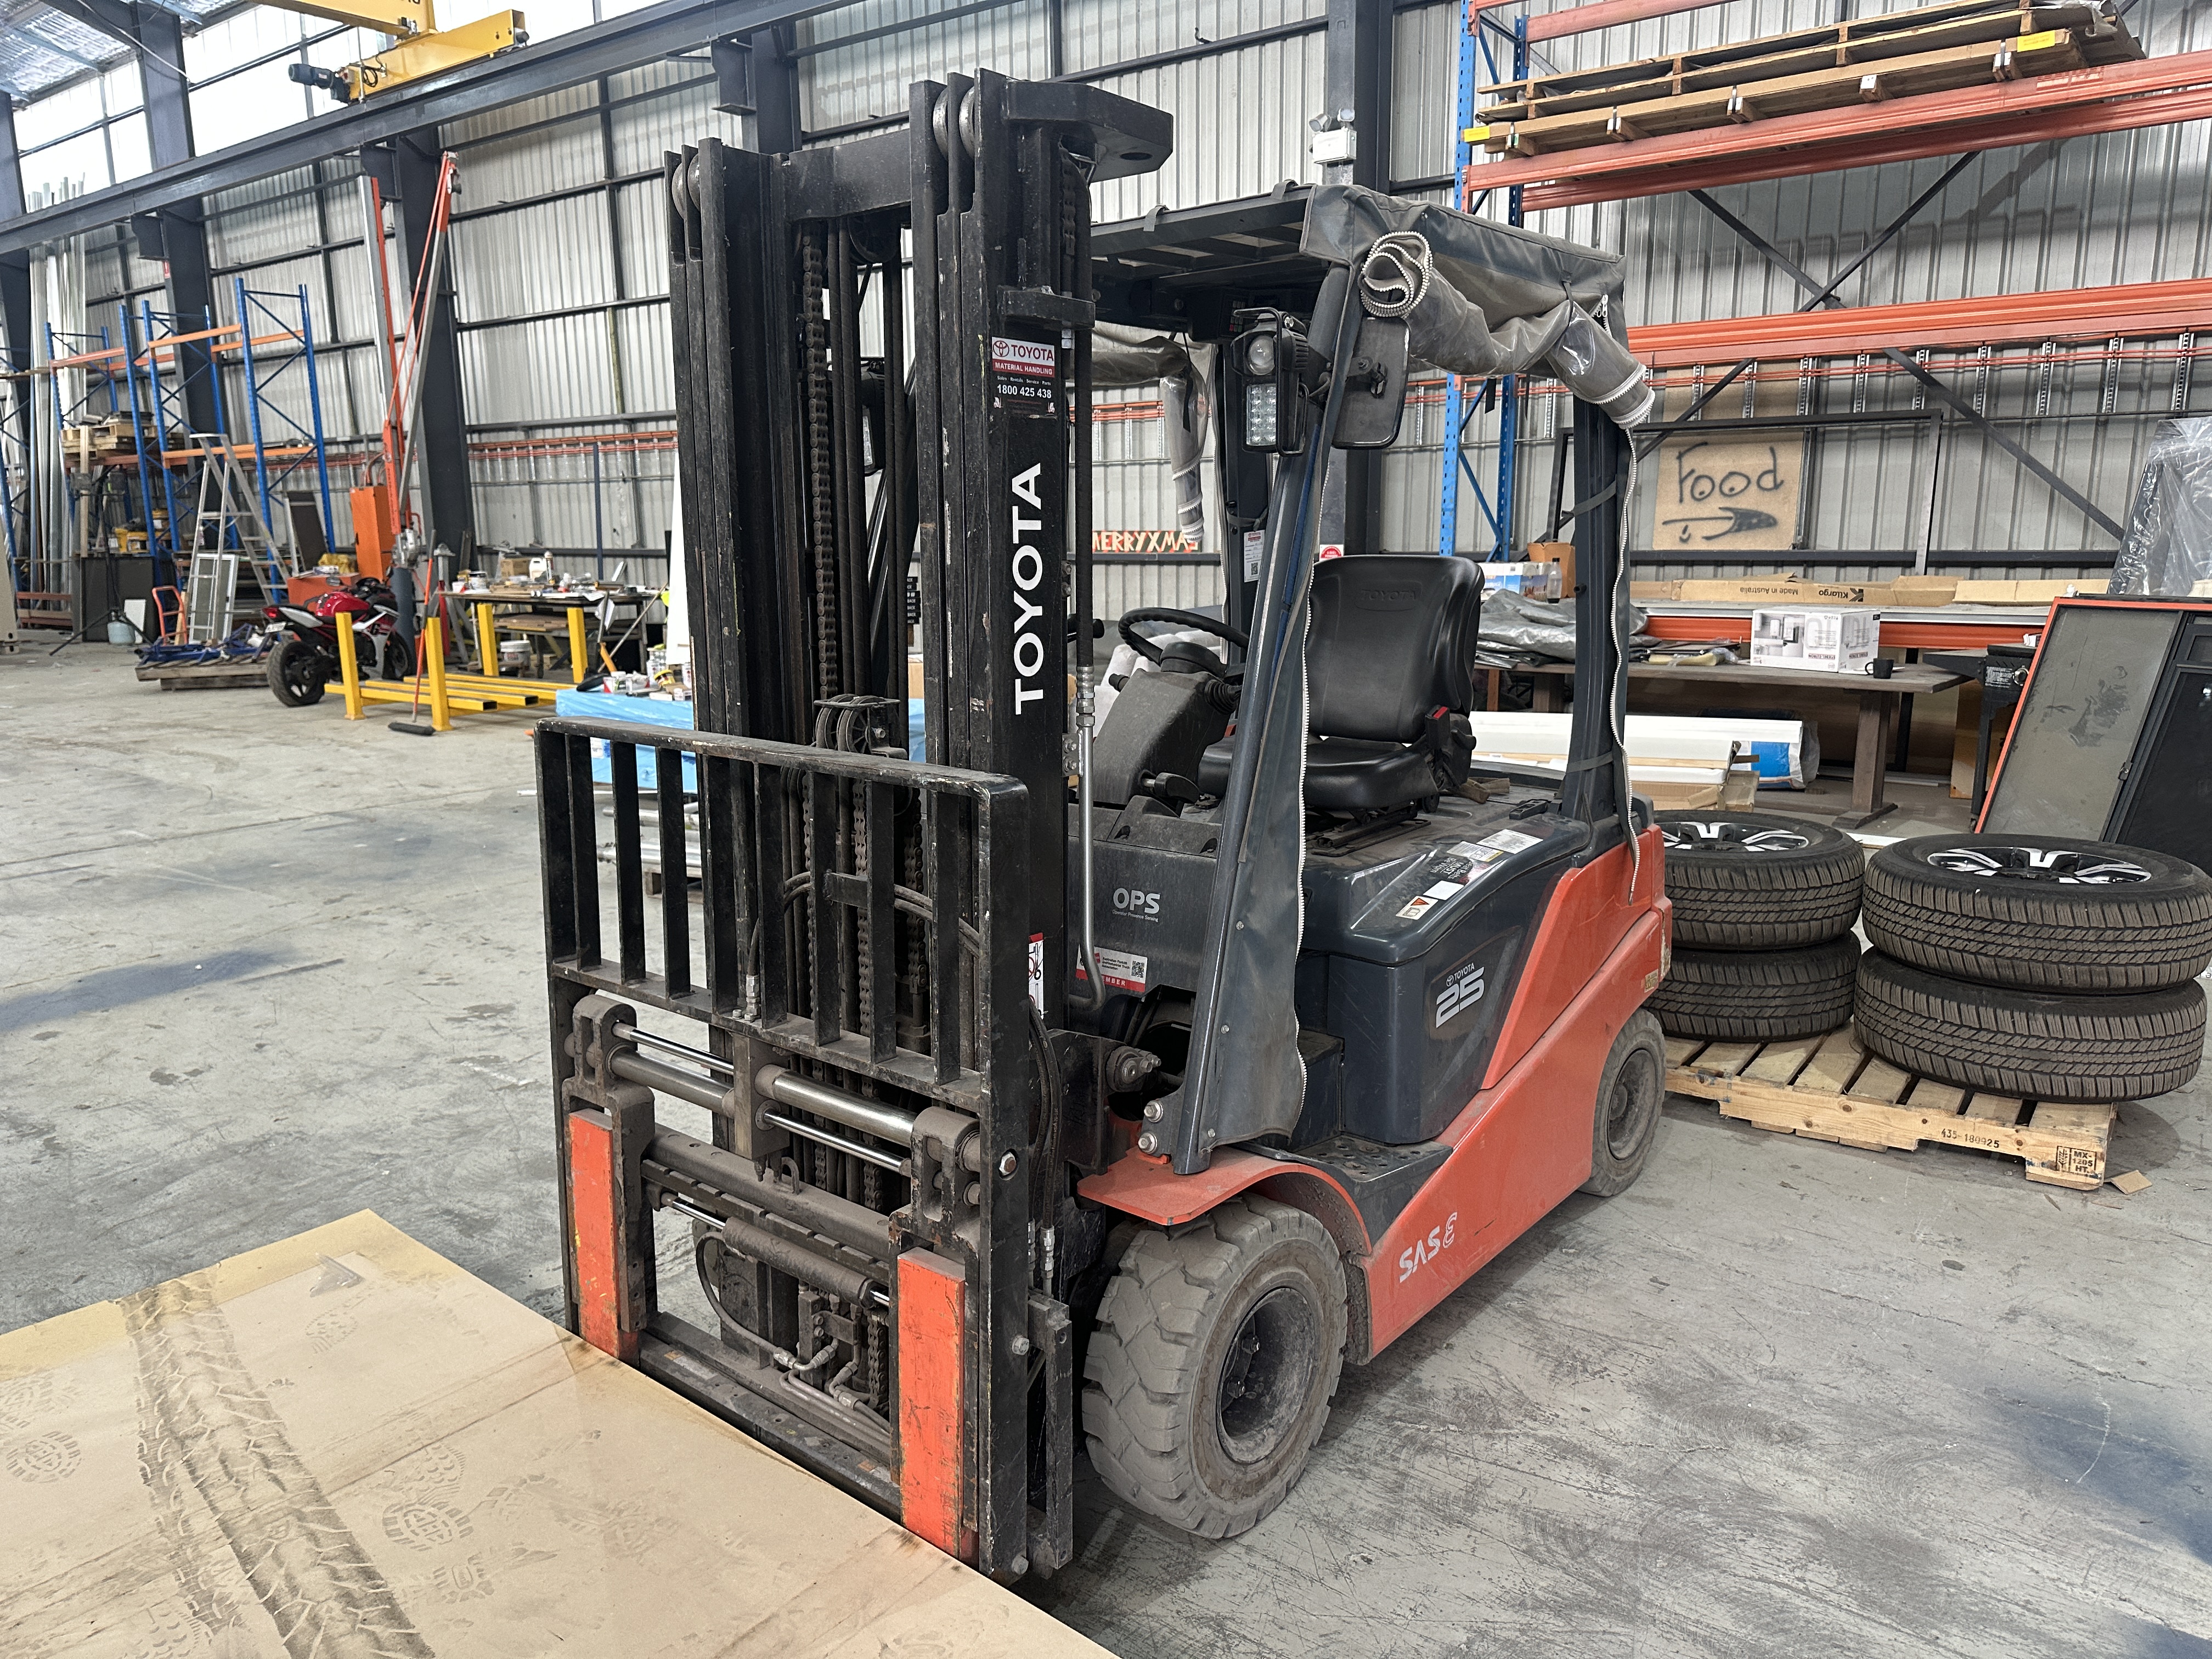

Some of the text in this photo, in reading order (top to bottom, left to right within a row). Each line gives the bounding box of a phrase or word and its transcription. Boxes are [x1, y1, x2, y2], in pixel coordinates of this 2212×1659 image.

[1011, 344, 1054, 362] TOYOTA
[995, 362, 1052, 375] MATERIAL HANDLING
[997, 384, 1052, 398] 1800 425 438
[1676, 441, 1784, 503] Food
[1012, 462, 1043, 715] TOYOTA
[1430, 862, 1448, 873] Worn
[1443, 861, 1464, 874] MUST
[1113, 888, 1160, 914] OPS
[1454, 962, 1475, 981] TOYOTA
[1436, 967, 1484, 1028] 25
[2072, 1158, 2093, 1167] 1205
[2074, 1150, 2092, 1159] MX-
[1399, 1226, 1440, 1283] SAS
